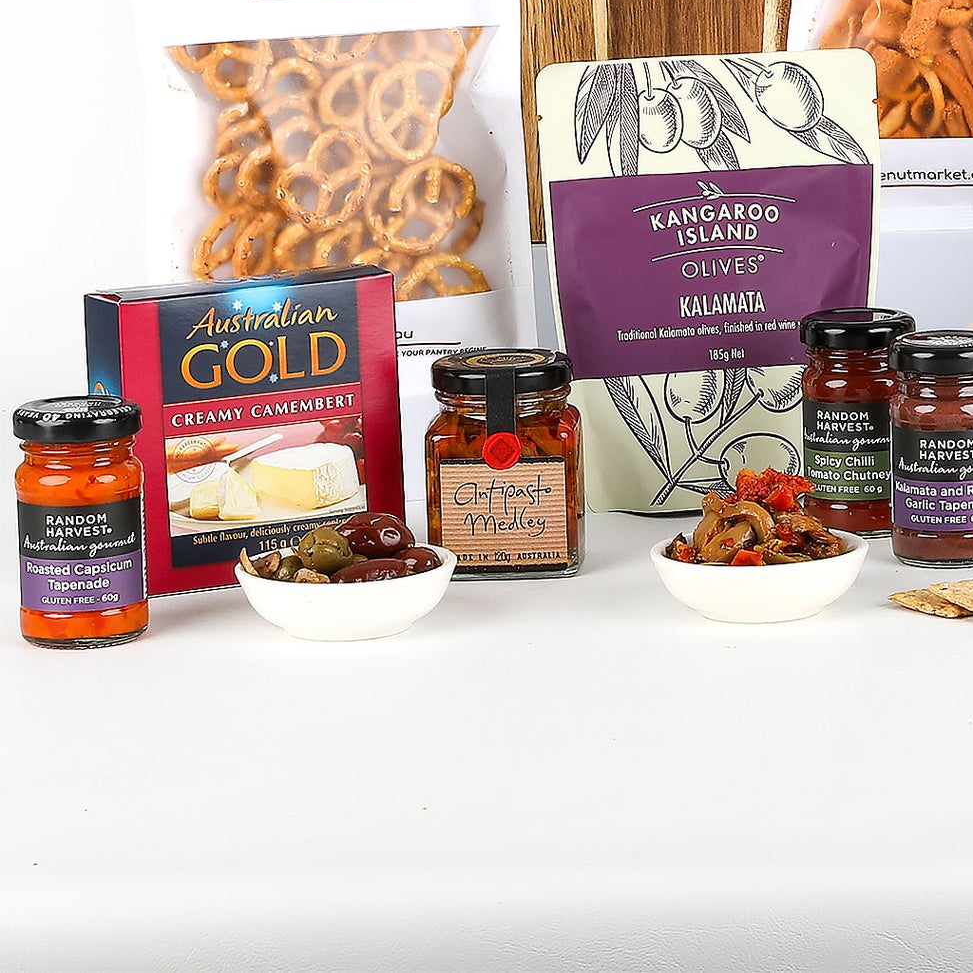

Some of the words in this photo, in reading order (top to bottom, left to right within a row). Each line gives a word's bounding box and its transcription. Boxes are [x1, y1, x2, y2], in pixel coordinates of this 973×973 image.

[650, 203, 780, 232] KANGAROO
[676, 222, 759, 247] ISLAND
[679, 290, 766, 318] KALAMATA
[186, 298, 338, 340] Australian
[616, 328, 657, 342] Traditional
[658, 326, 696, 340] Kalamata
[723, 320, 754, 334] finished
[755, 320, 763, 332] in
[764, 319, 777, 331] red
[778, 319, 796, 330] wine
[180, 331, 347, 390] GOLD
[401, 349, 424, 357] YOUR
[425, 348, 458, 356] PANTRY
[708, 349, 730, 363] 185g
[731, 348, 745, 360] Net
[171, 407, 243, 428] CREAMY
[250, 393, 355, 418] CAMEMBERT
[816, 410, 869, 421] RANDOM
[814, 454, 842, 468] Spicy
[845, 455, 875, 467] Chilli
[898, 457, 958, 474] Australian
[806, 466, 840, 481] Tomato
[843, 470, 892, 481] Chutney
[815, 483, 837, 493] LUTEN
[838, 485, 860, 494] FREE
[863, 485, 875, 493] 60
[876, 485, 883, 493] g
[895, 480, 937, 497] Kalamata
[940, 486, 964, 497] and
[905, 497, 936, 510] Garlic
[46, 513, 107, 525] RANDOM
[464, 507, 546, 538] Medley
[910, 514, 943, 524] GLUTEN
[944, 515, 967, 524] FREE
[192, 532, 218, 546] Subtle
[250, 523, 291, 538] deliciously
[23, 534, 88, 552] Australian
[88, 531, 136, 558] gourmet
[259, 538, 277, 552] 115
[517, 551, 561, 560] AUSTRALIA
[26, 561, 70, 576] Roasted
[74, 559, 132, 576] Capsicum
[47, 578, 110, 592] Tapenade
[41, 596, 72, 605] GLUTEN
[73, 596, 95, 604] FREE
[101, 593, 119, 603] 60g
